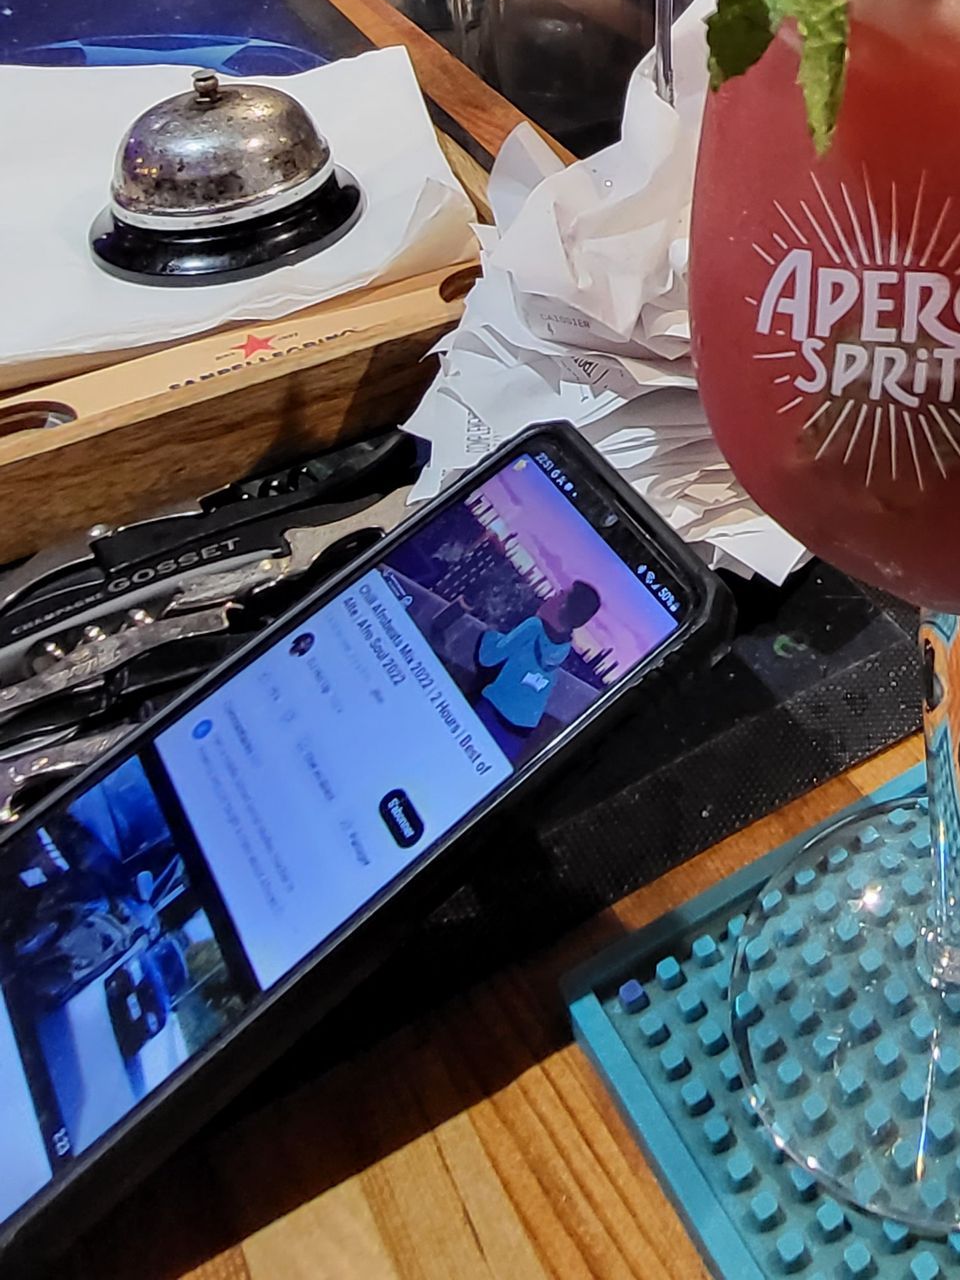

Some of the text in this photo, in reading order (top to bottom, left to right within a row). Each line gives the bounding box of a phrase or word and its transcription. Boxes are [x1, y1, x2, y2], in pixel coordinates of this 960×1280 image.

[107, 535, 241, 594] GOSSET
[382, 655, 406, 687] 2022
[409, 661, 434, 696] 2022
[435, 697, 458, 735] Hours
[475, 756, 493, 776] of
